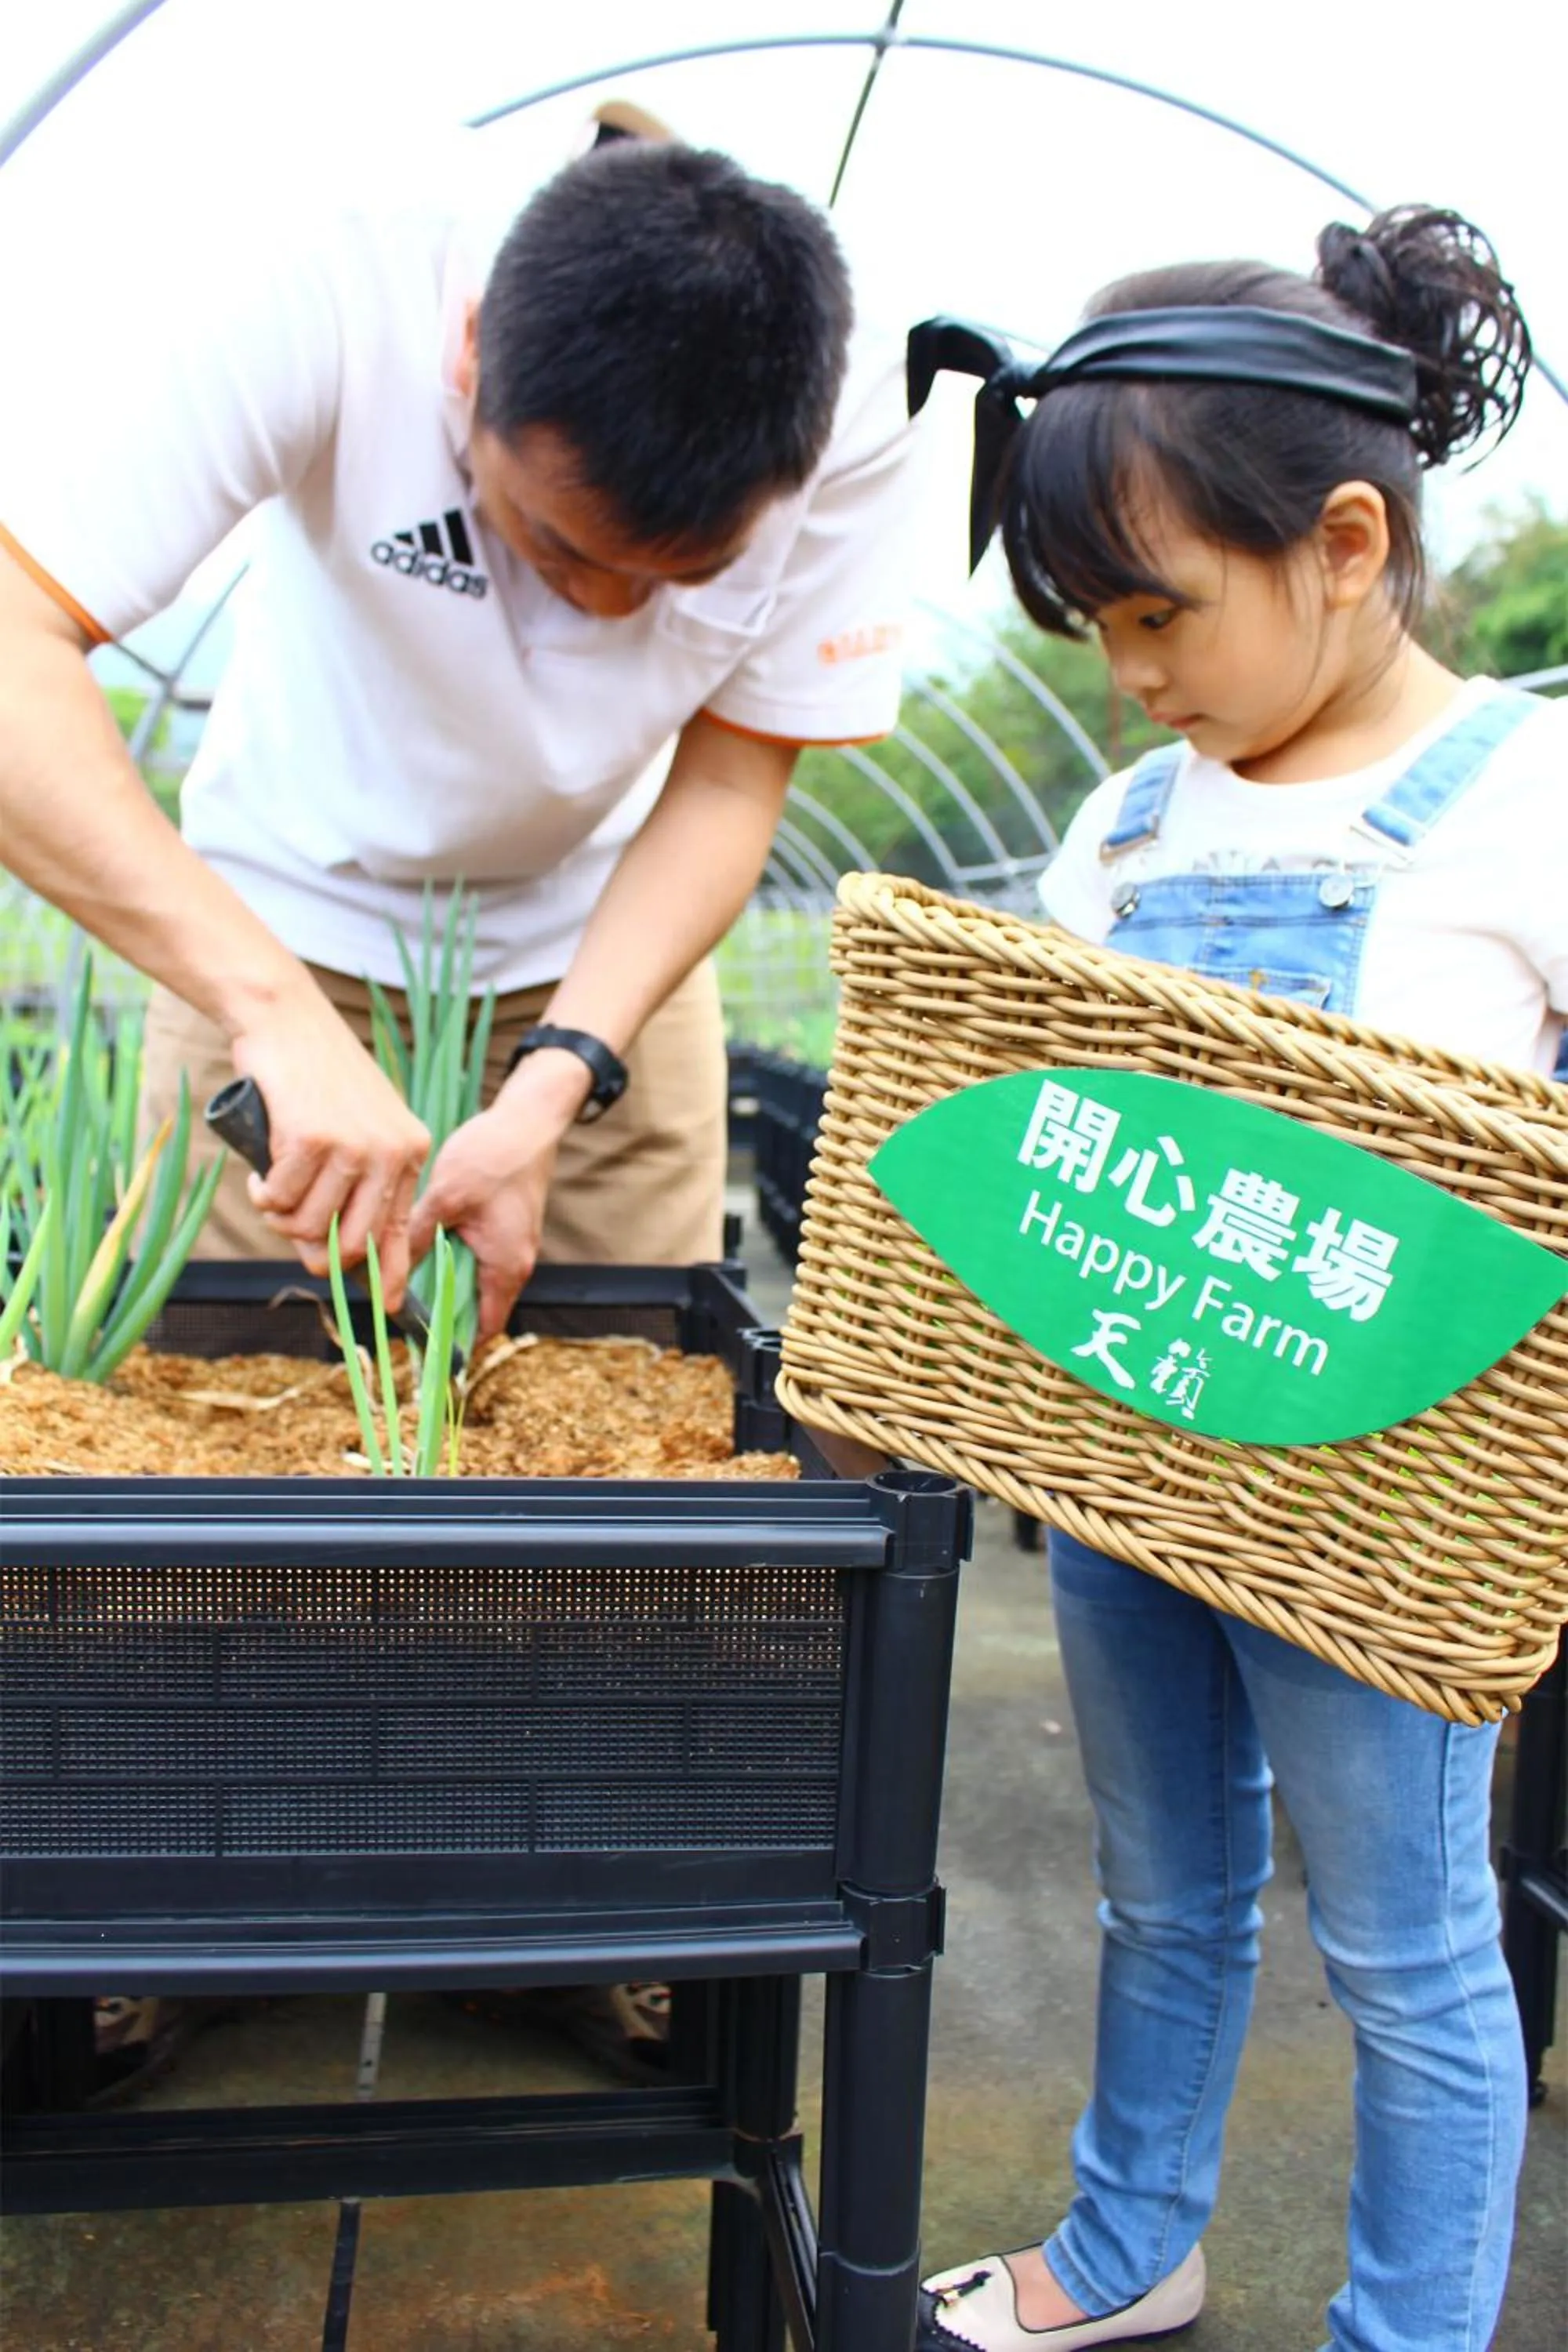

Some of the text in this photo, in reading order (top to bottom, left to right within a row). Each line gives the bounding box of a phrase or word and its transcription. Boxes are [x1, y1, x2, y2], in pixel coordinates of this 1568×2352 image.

[371, 541, 488, 599] adidas
[1017, 1079, 1399, 1322] 開心農場
[1019, 1190, 1330, 1376] Happy Farm
